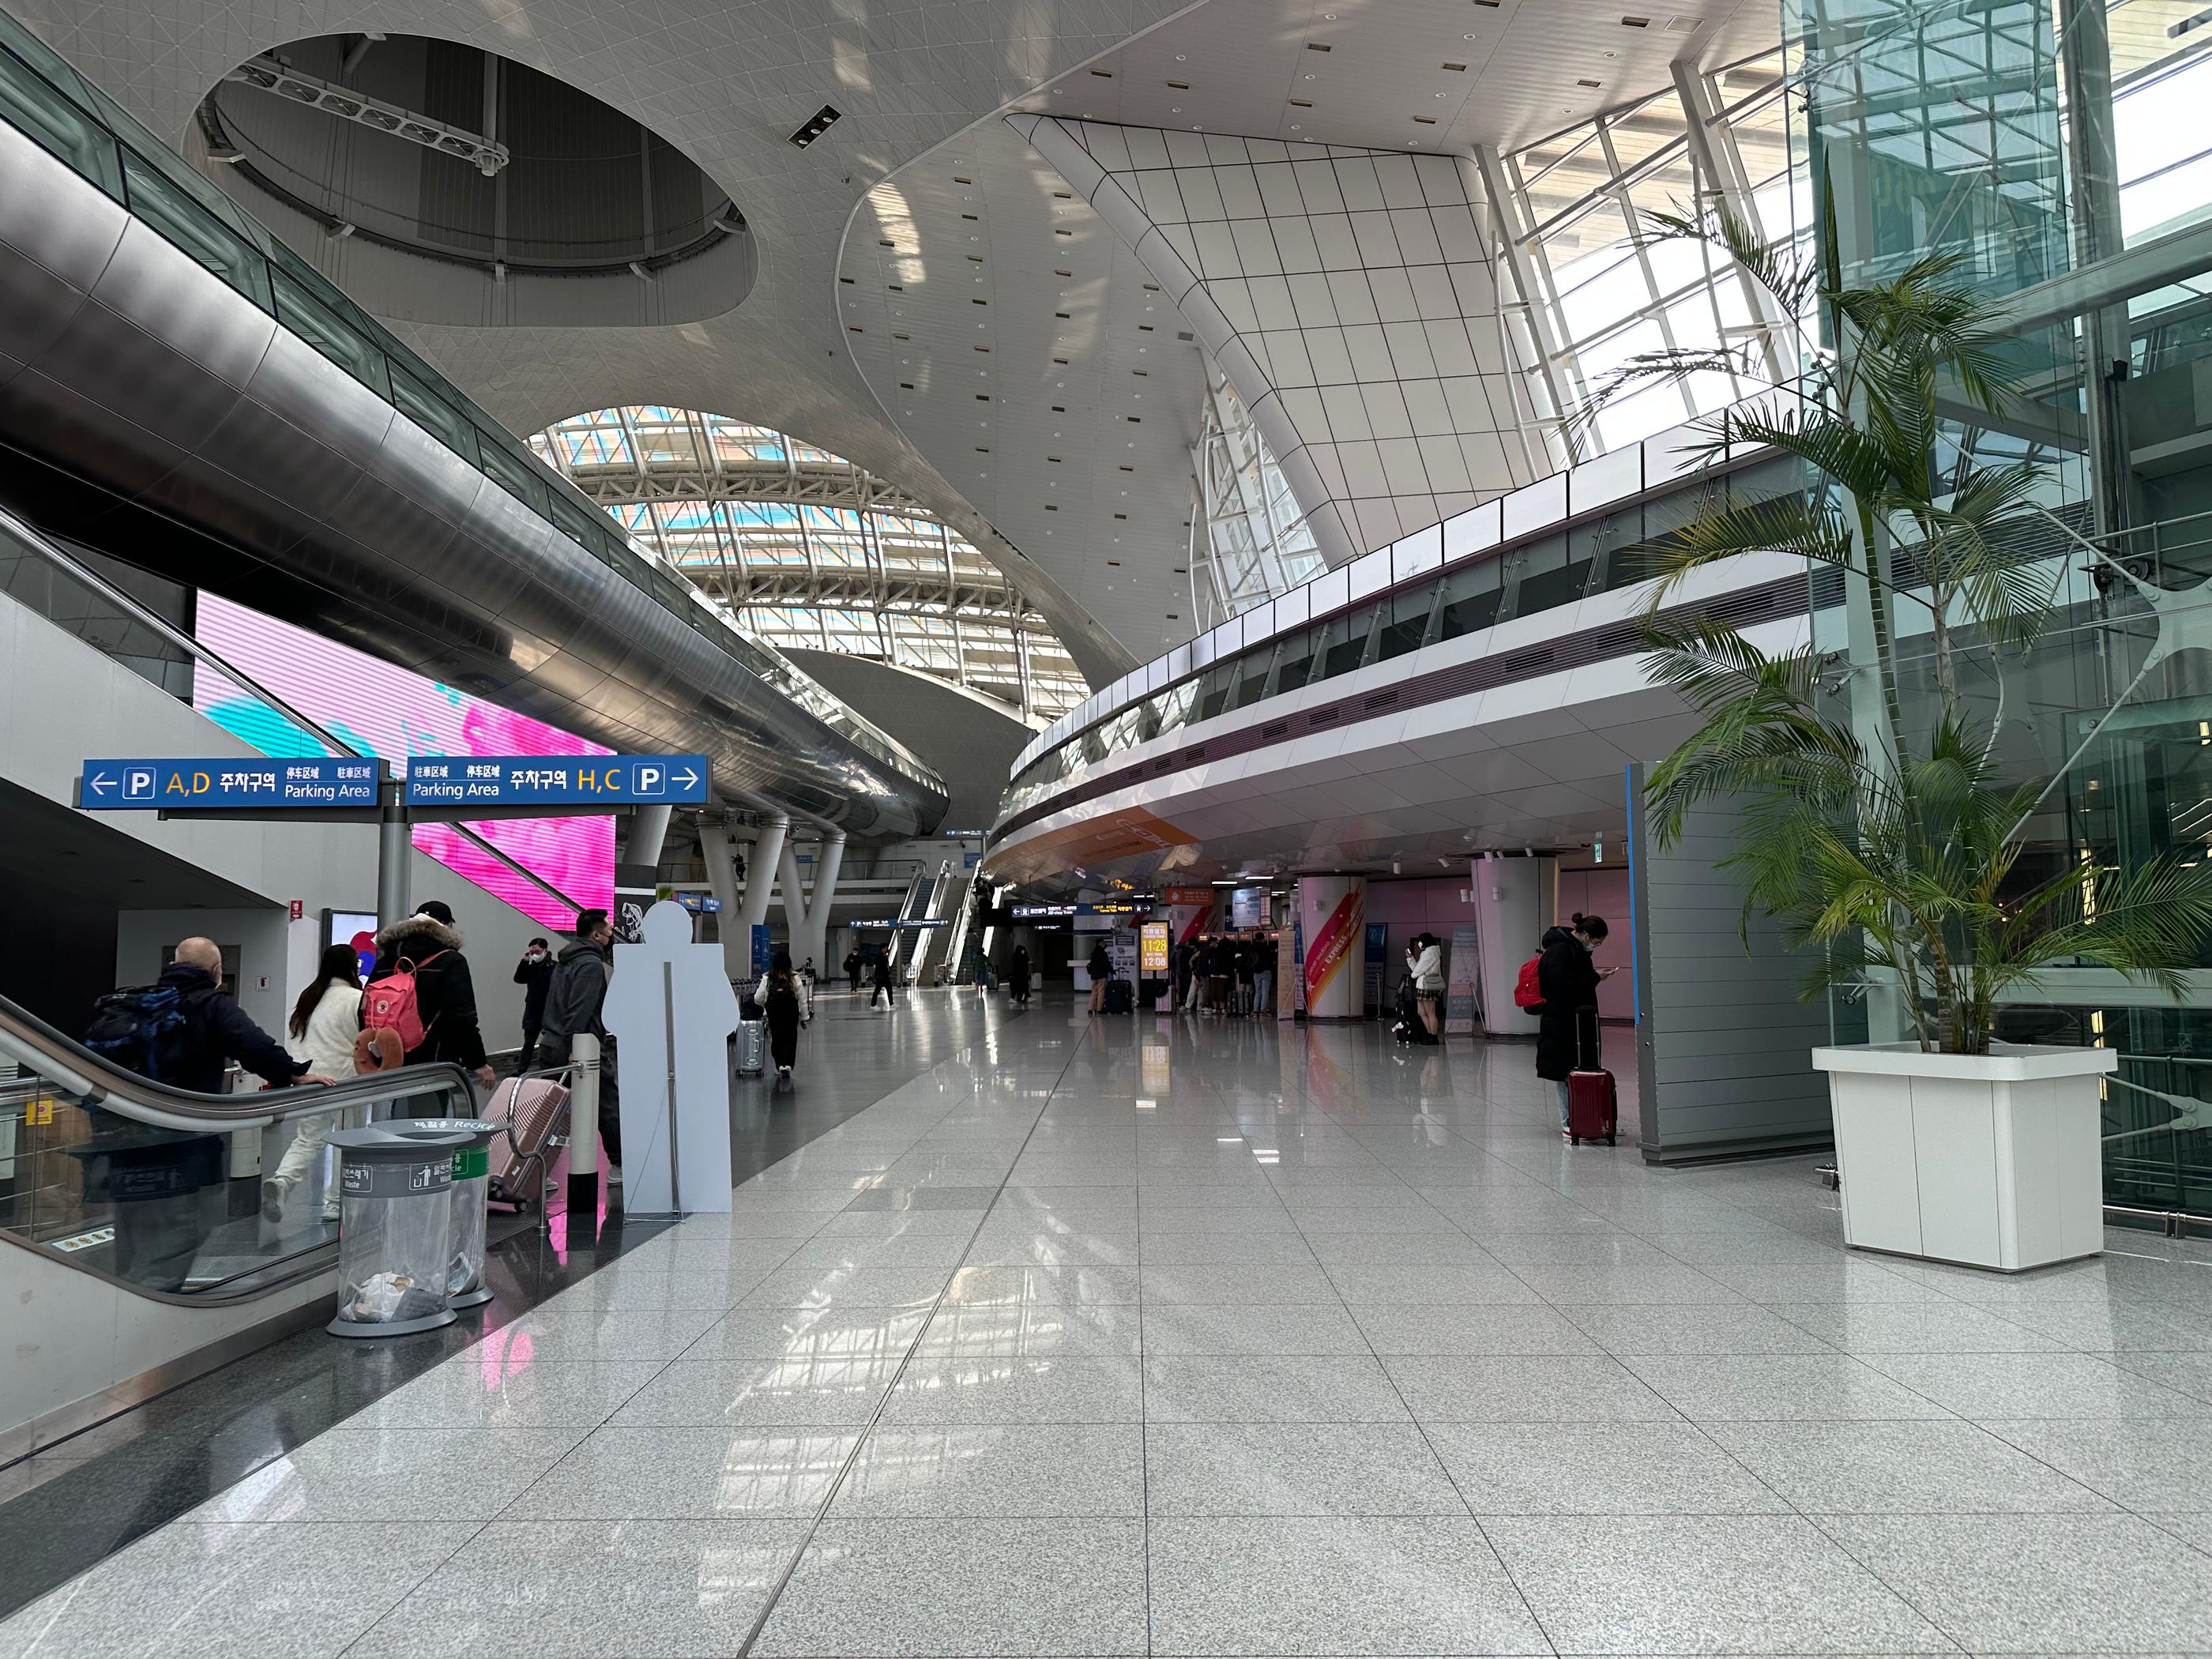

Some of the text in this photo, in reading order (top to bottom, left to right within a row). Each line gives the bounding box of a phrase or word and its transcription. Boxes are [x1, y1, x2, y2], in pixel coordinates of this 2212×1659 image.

[287, 766, 371, 780] 停车区域 駐車区域
[414, 765, 500, 778] 駐車区域 停车区域
[131, 772, 276, 797] P A,D 주차구역
[510, 768, 660, 793] 주차구역 H,C P
[285, 784, 370, 801] Parking Area
[413, 782, 499, 799] Parking Area
[1142, 939, 1167, 952] 11:28
[1325, 935, 1348, 964] EXPRESS
[1144, 957, 1166, 967] 12:08
[414, 1120, 495, 1130] 재활용 Recycle
